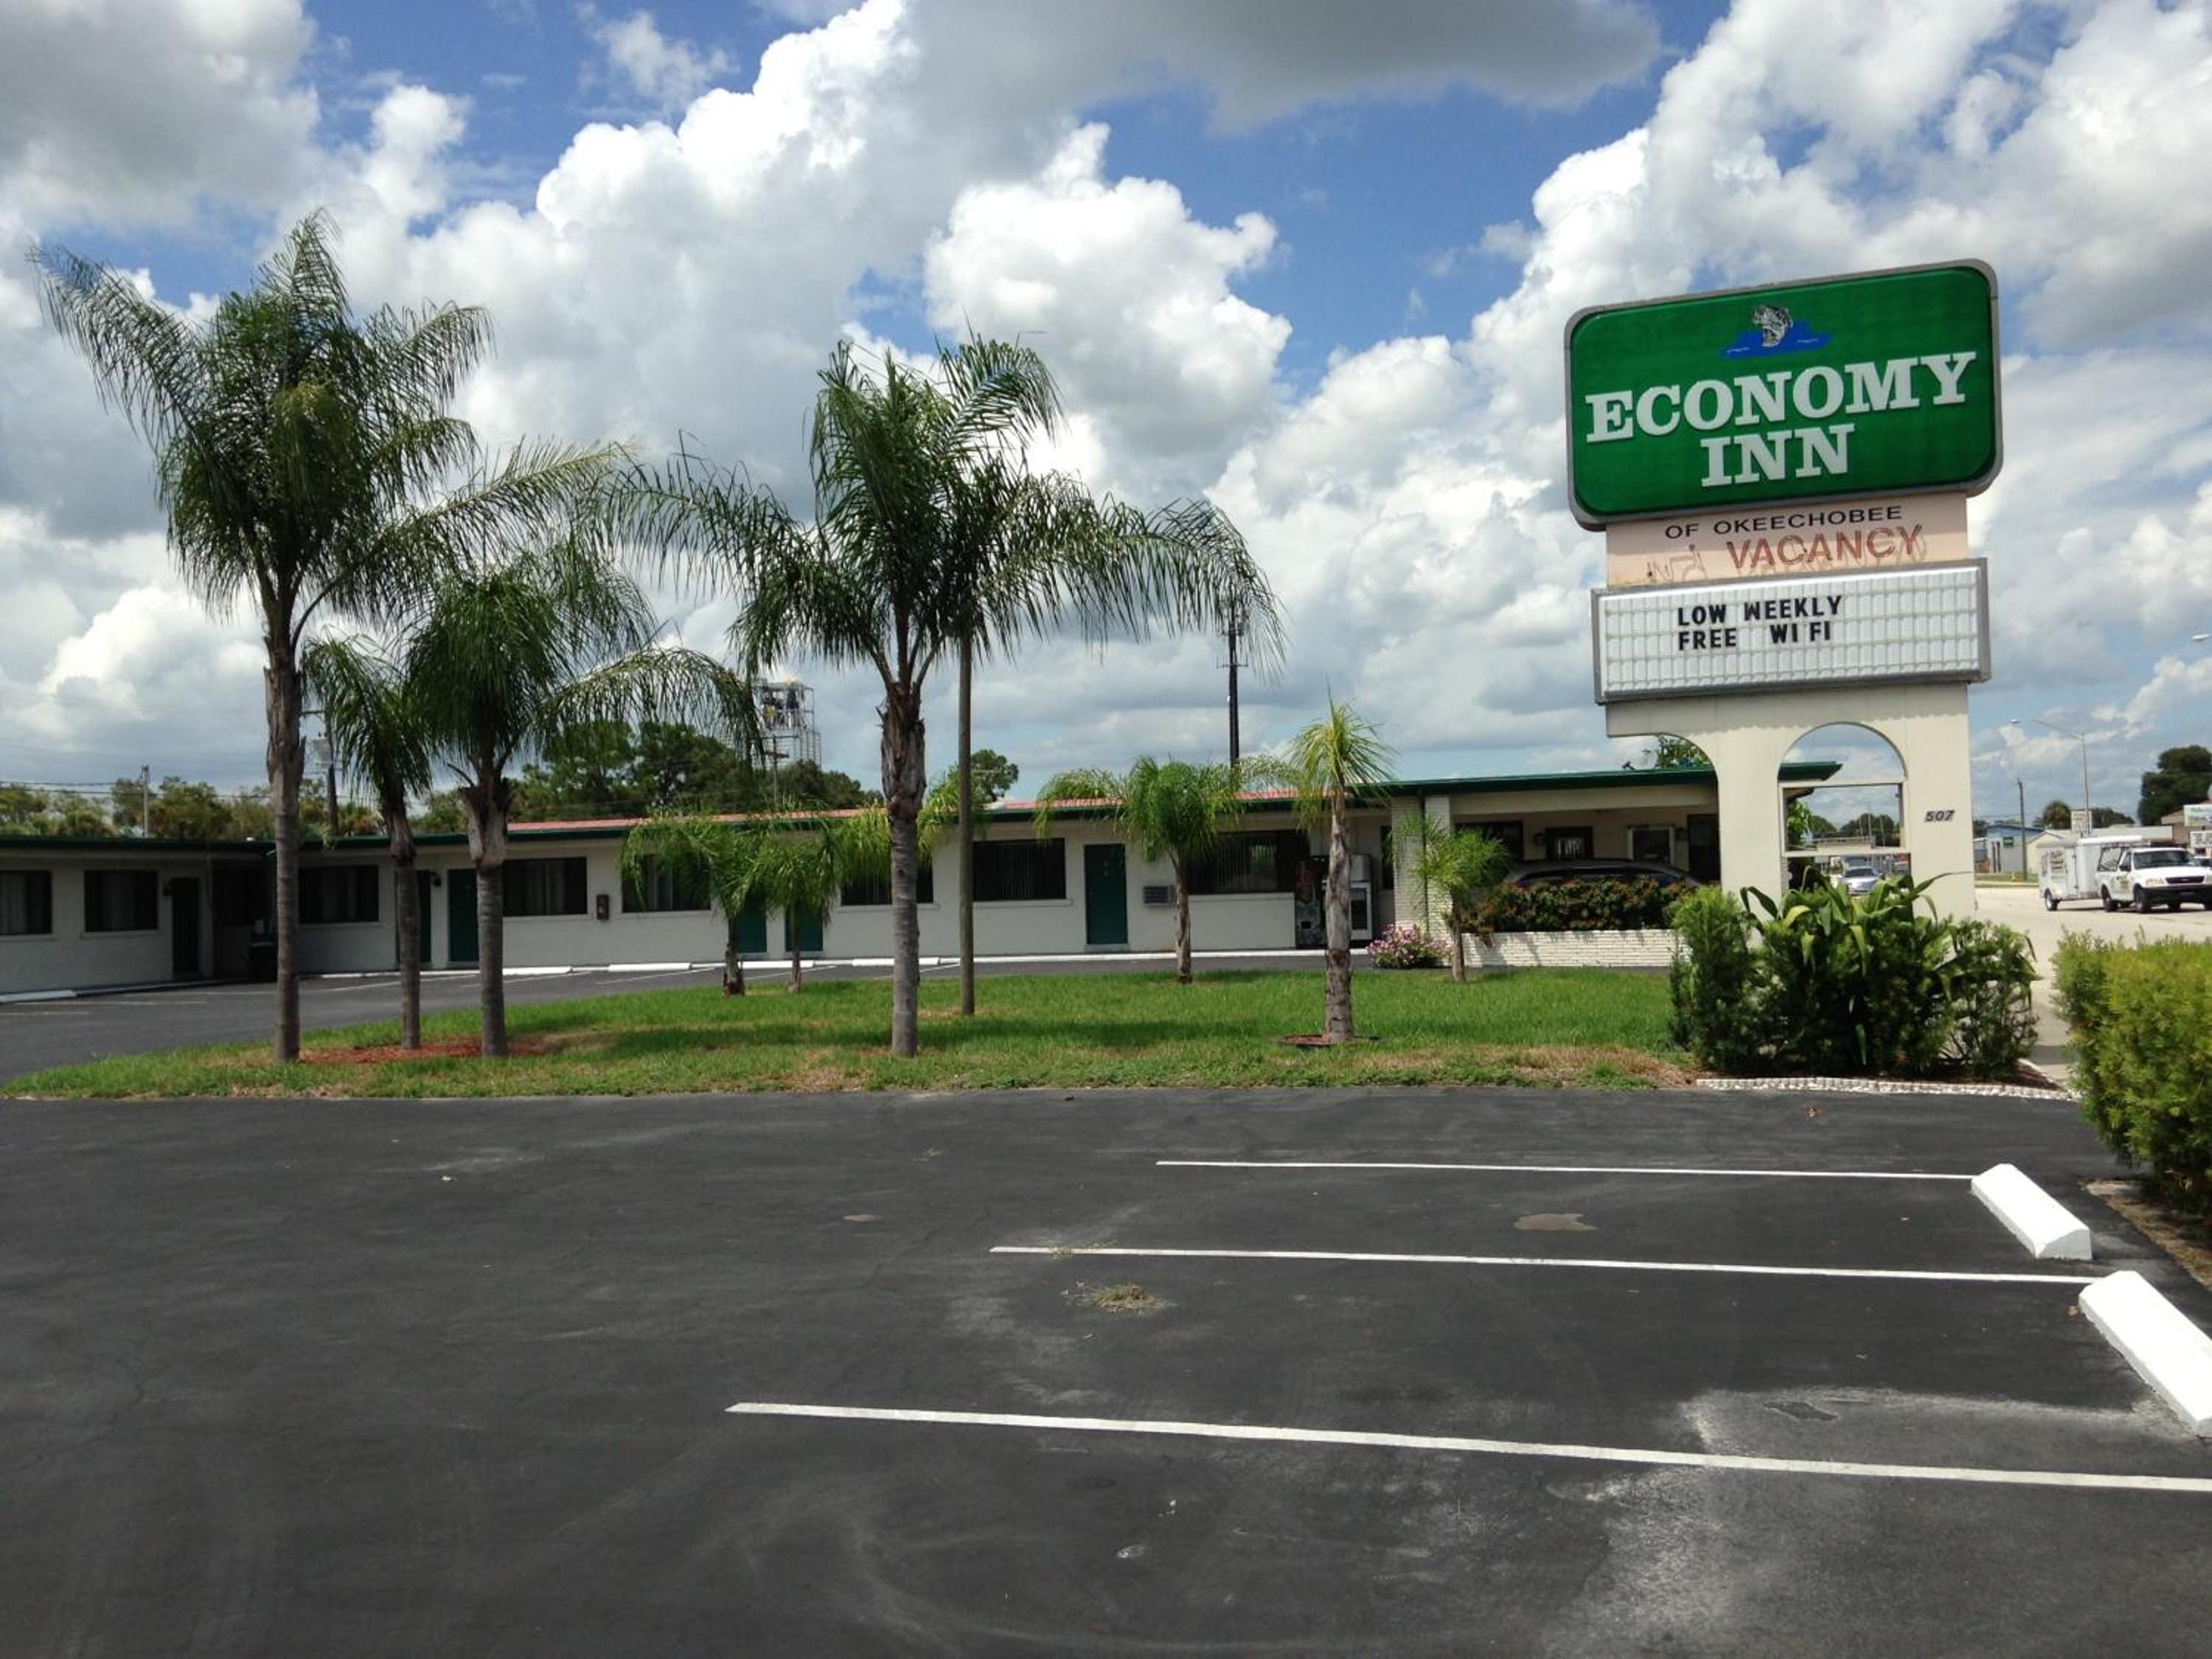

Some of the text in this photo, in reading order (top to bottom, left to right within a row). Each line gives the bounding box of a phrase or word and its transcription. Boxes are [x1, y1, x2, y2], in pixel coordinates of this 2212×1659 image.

[1585, 352, 1976, 442] ECONOMY
[1701, 423, 1855, 487] INN
[1665, 507, 1902, 539] OF OKEECHOBEE
[1726, 524, 1922, 569] VACANCY
[1677, 595, 1842, 626] LOW WEEKLY
[1678, 627, 1736, 650] FREE
[1924, 810, 1955, 822] 507
